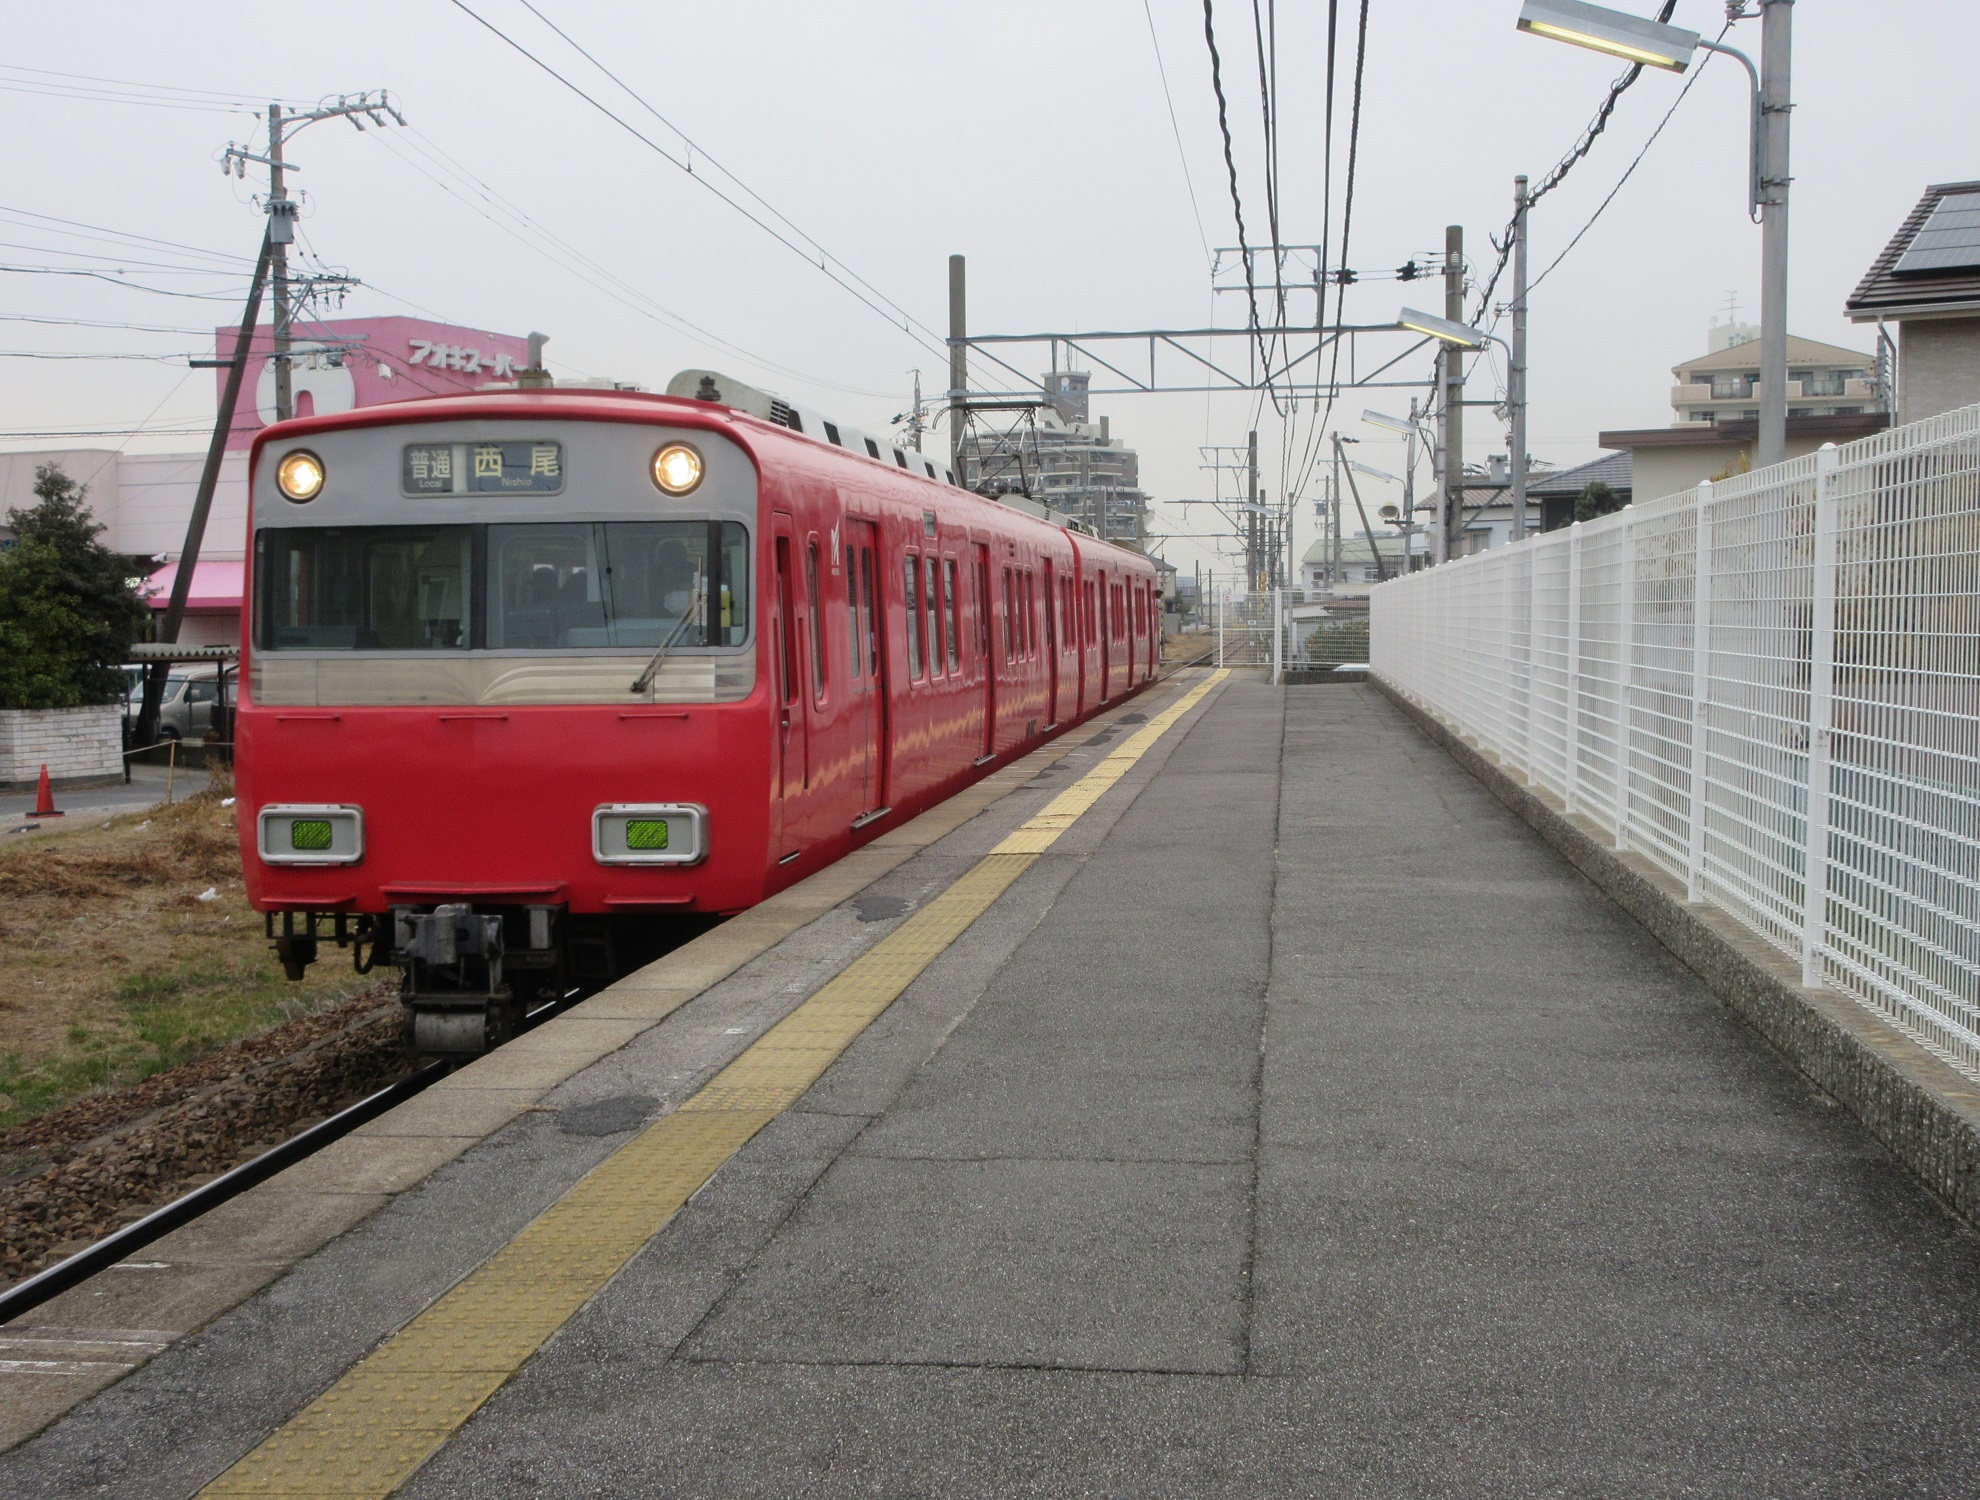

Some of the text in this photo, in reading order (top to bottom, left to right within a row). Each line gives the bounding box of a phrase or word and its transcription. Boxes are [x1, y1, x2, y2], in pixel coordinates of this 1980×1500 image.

[410, 450, 450, 479] 普通
[419, 480, 442, 488] Local
[502, 477, 532, 486] Nishio
